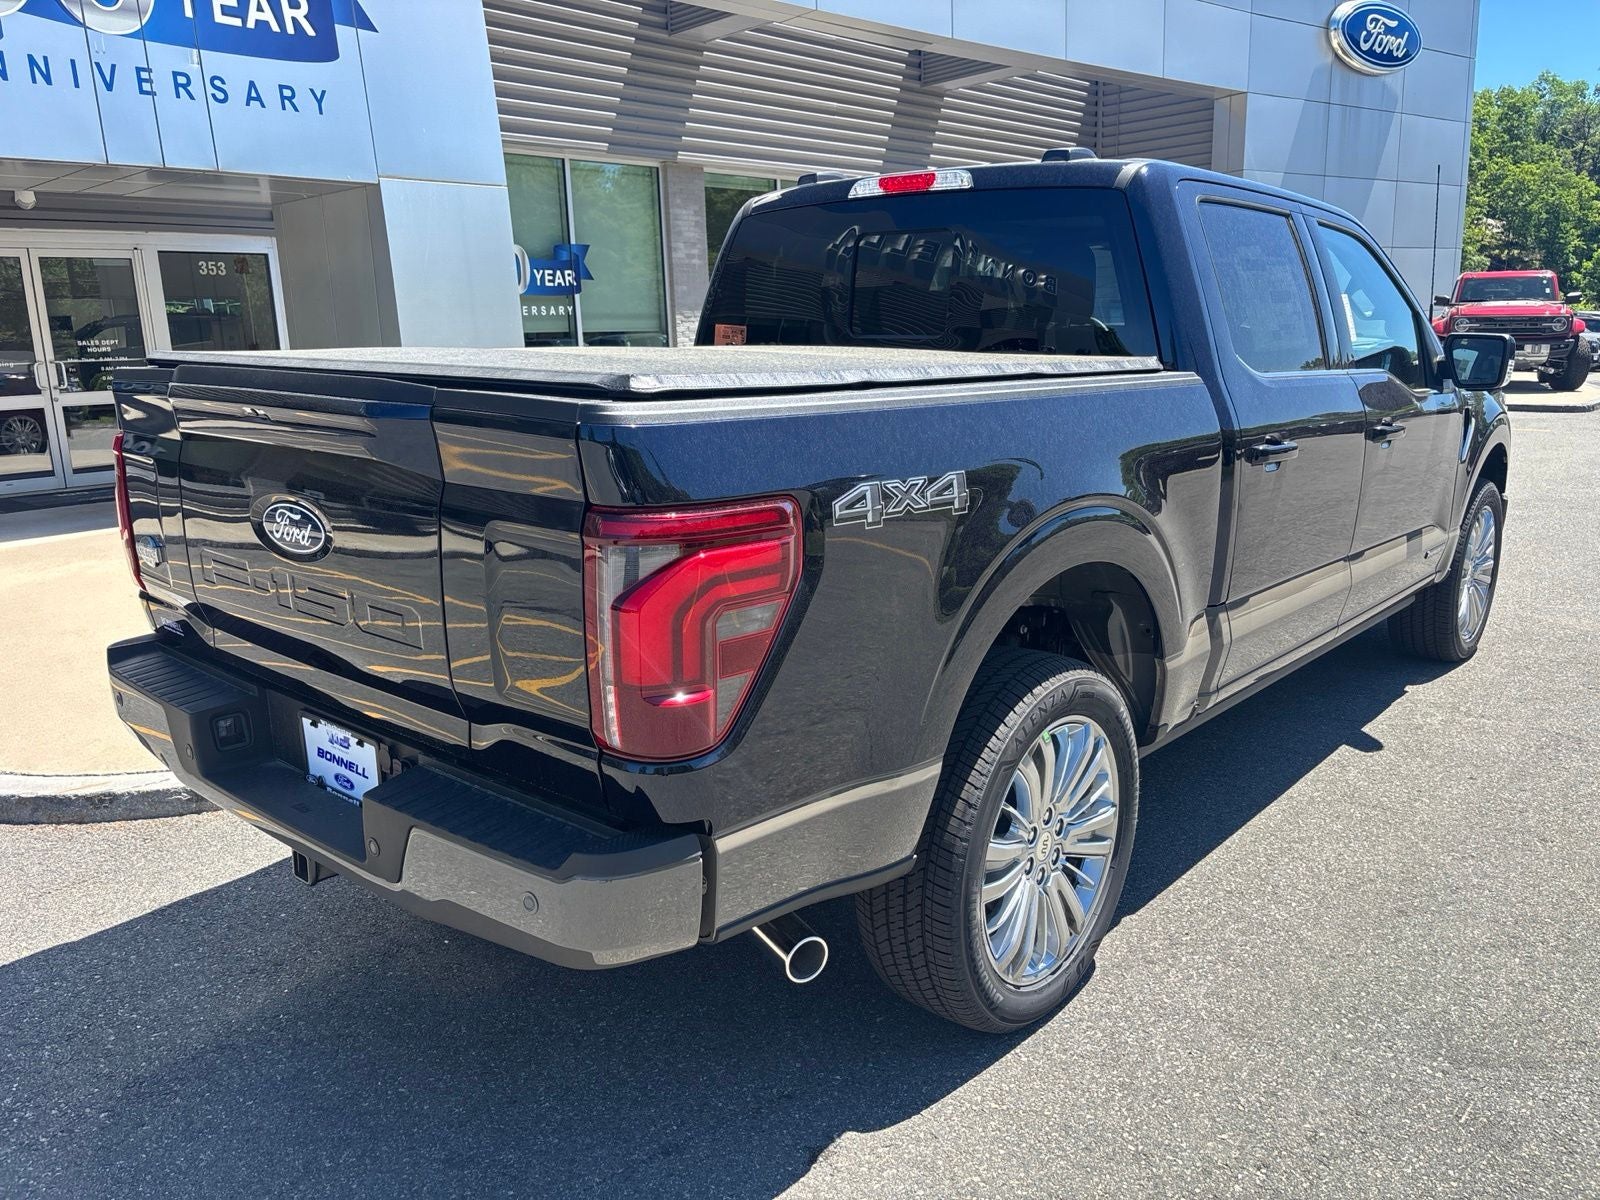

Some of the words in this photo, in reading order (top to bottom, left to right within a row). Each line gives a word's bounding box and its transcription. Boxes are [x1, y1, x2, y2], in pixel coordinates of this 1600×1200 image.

[1359, 13, 1409, 58] Ford
[198, 260, 227, 276] 353
[533, 268, 577, 287] YEAR
[271, 508, 312, 547] Ford
[1014, 688, 1068, 749] ALENZA
[316, 745, 370, 780] BONNELL
